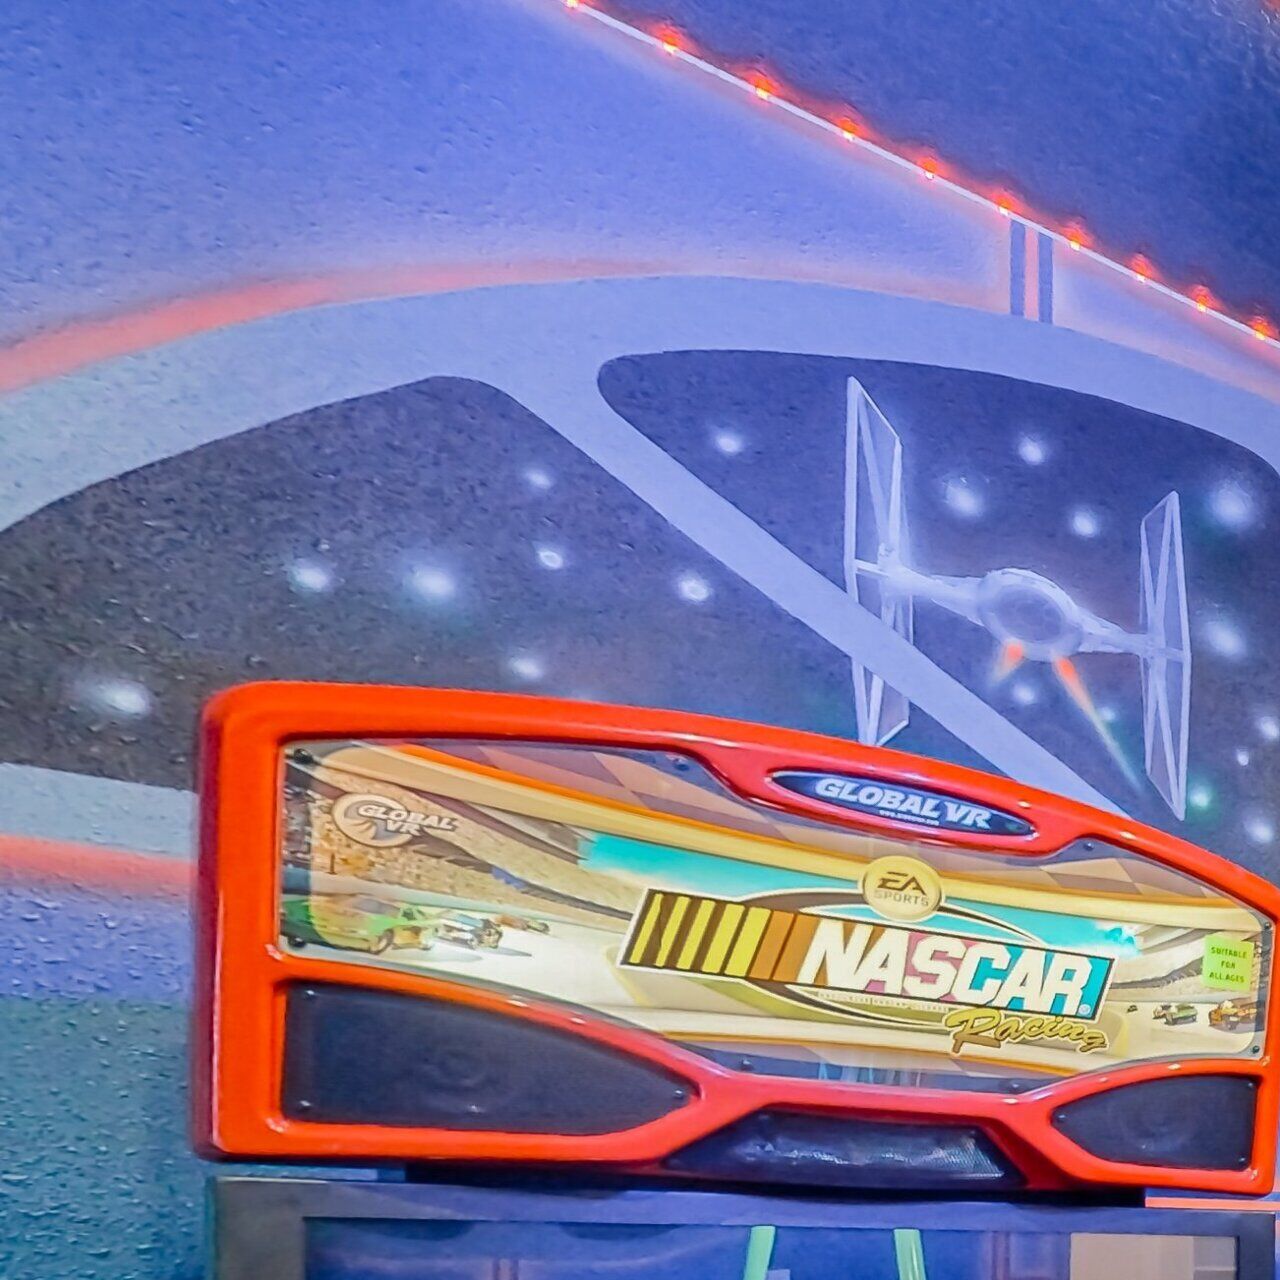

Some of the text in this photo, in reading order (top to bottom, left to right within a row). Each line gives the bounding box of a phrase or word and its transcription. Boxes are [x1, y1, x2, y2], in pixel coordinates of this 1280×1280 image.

[815, 778, 941, 819] GLOBAL
[944, 802, 991, 829] VR
[358, 804, 456, 831] GLOBAL
[386, 819, 422, 836] VR
[877, 871, 927, 896] EA
[874, 890, 929, 907] SPORTS
[1211, 946, 1247, 959] SUITABLE
[797, 918, 1092, 1016] NASCAR
[945, 1008, 1108, 1053] Racing
